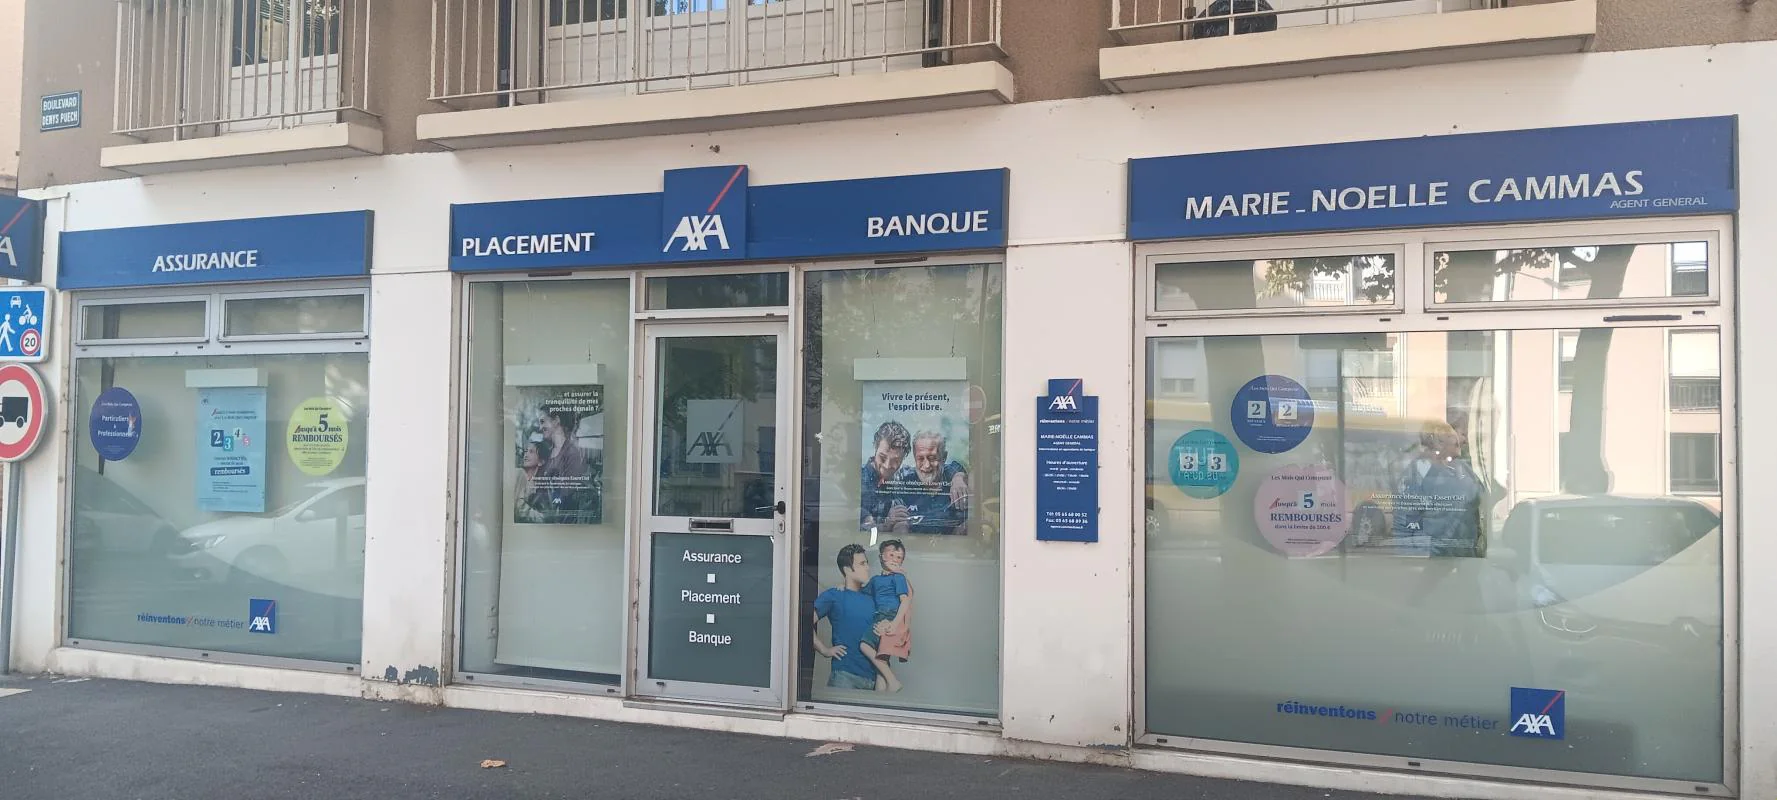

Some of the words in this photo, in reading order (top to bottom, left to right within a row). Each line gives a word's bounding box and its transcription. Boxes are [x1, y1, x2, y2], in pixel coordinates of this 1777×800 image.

[43, 97, 77, 110] BOULEVARD
[60, 110, 77, 123] PUECH
[1185, 191, 1290, 220] MARIE
[1468, 170, 1644, 204] CAMMAS
[1610, 199, 1650, 209] AGENT
[1652, 196, 1708, 207] GENERAL
[866, 209, 989, 239] BANQUE
[662, 214, 730, 252] AXA
[462, 232, 595, 257] PLACEMENT
[151, 249, 258, 273] ASSURANCE
[24, 337, 36, 348] 20
[881, 392, 904, 401] Vivre
[905, 392, 913, 401] le
[914, 391, 950, 403] présent,
[1049, 396, 1077, 410] AXA
[550, 405, 572, 413] proches
[573, 404, 594, 412] demain
[888, 402, 919, 412] l'esprit
[920, 402, 943, 411] libre.
[1251, 403, 1261, 416] 2
[1282, 404, 1292, 417] 2
[318, 413, 329, 433] 5
[213, 431, 223, 445] 2
[234, 428, 241, 438] 4
[292, 432, 343, 443] REMBOURSÉS
[224, 437, 232, 450] 3
[687, 431, 733, 456] AXA
[1183, 455, 1194, 470] 3
[1210, 456, 1222, 471] 3
[1303, 492, 1314, 509] 5
[1270, 512, 1342, 523] REMBOURSÉS
[682, 549, 742, 564] Assurance
[681, 589, 741, 605] Placement
[137, 612, 186, 625] réinventons
[194, 618, 215, 627] notre
[217, 618, 244, 629] métier
[250, 616, 271, 631] AXA
[688, 630, 732, 646] Banque
[1276, 700, 1377, 721] réinventons
[1394, 710, 1438, 726] notre
[1443, 713, 1500, 730] métier
[1510, 712, 1556, 735] AXA
